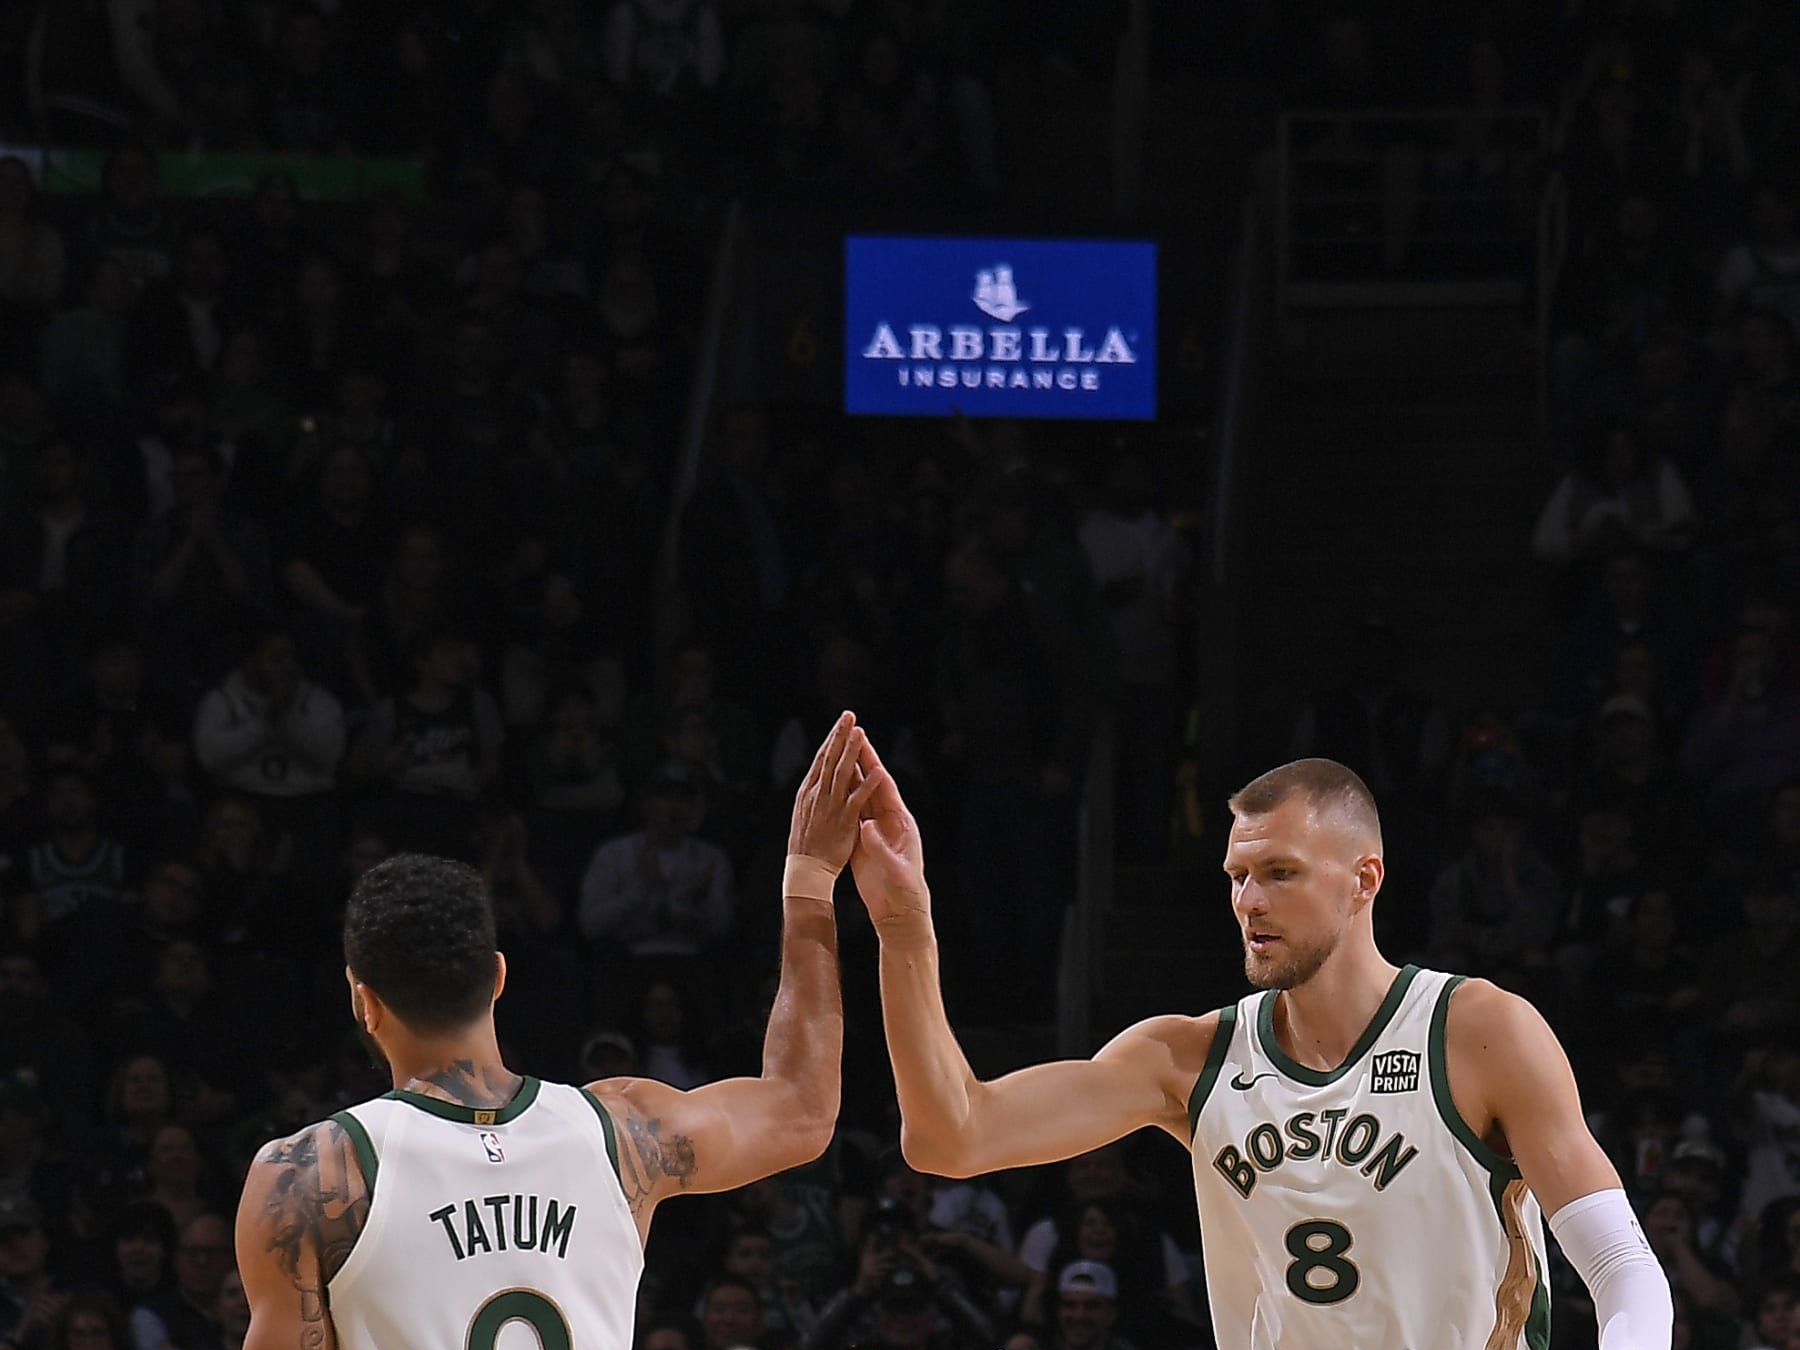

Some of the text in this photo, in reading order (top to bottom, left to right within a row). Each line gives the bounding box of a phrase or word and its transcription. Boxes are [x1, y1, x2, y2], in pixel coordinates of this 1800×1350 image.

[863, 322, 1136, 364] ARBELLA
[899, 367, 1099, 390] INSURANCE
[1373, 1074, 1416, 1092] PRINT
[1375, 1054, 1417, 1075] VISTA
[1212, 1107, 1420, 1201] BOSTON
[428, 1193, 578, 1262] TATUM
[1282, 1217, 1362, 1307] 8
